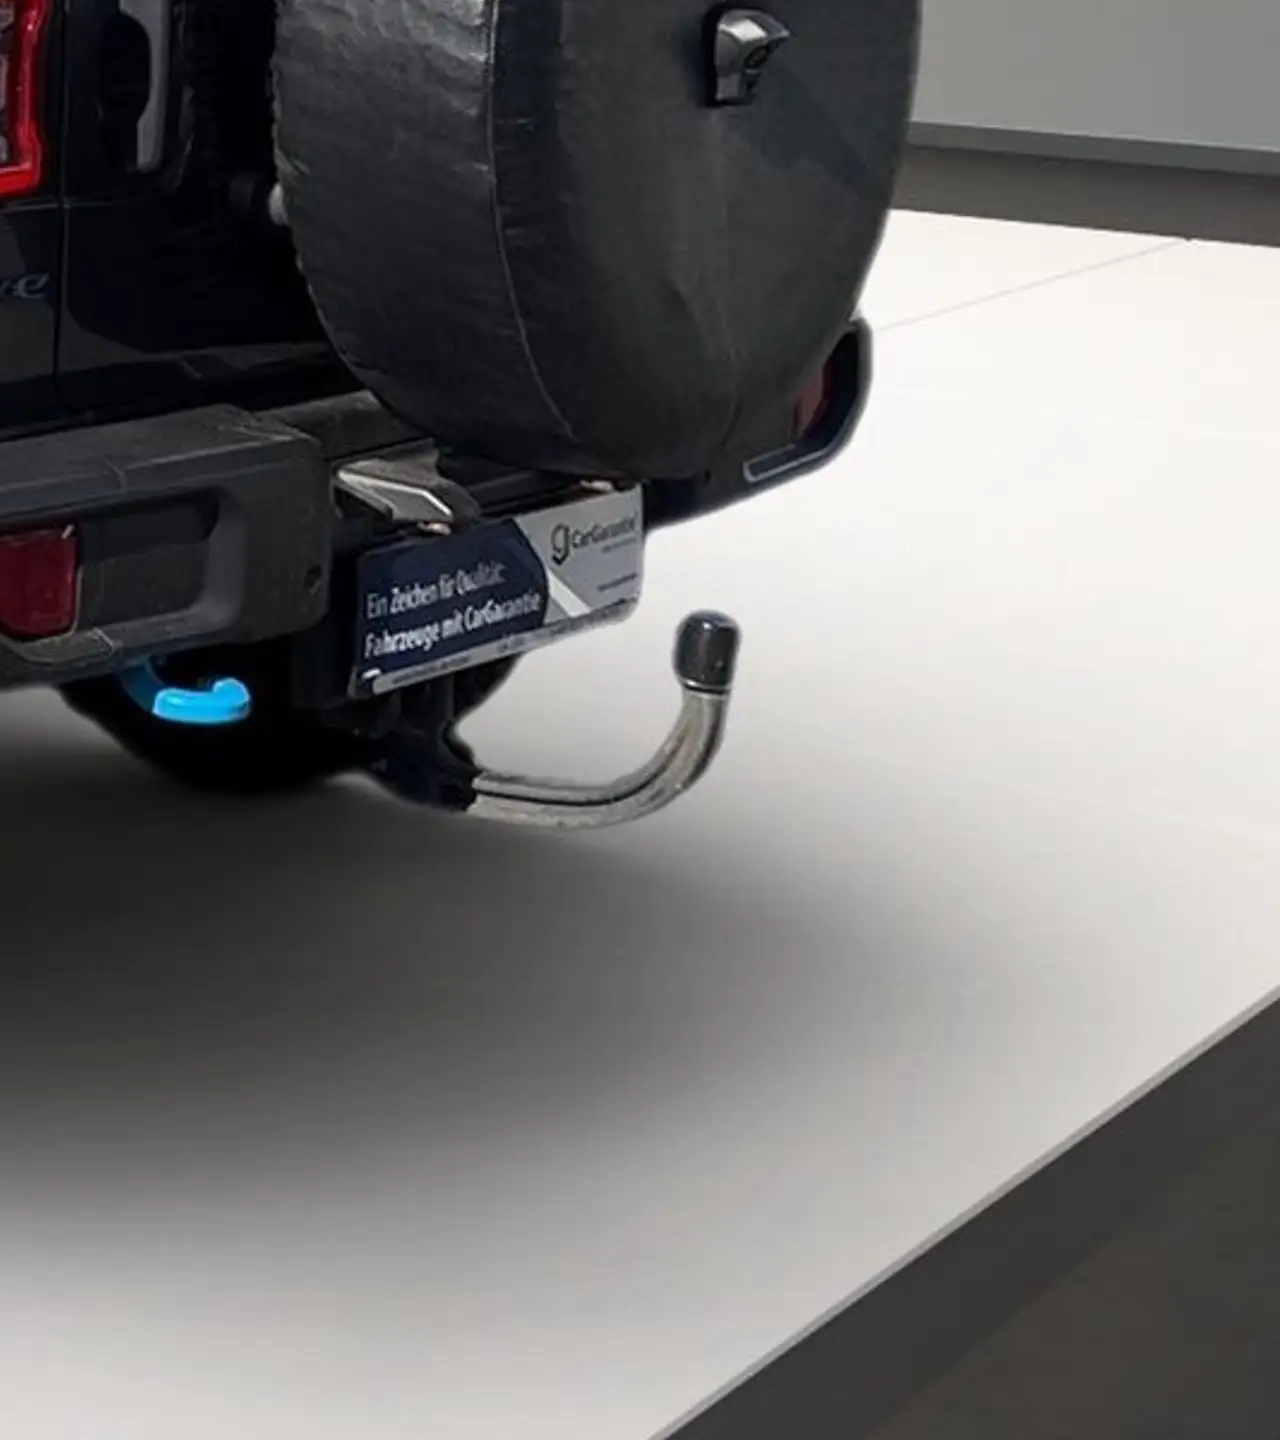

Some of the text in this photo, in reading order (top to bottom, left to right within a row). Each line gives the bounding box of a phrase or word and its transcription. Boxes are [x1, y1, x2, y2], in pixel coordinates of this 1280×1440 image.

[366, 593, 389, 620] Ein
[390, 582, 438, 614] Zeichen
[364, 622, 440, 659] Fahrzeuge
[441, 610, 464, 640] mit
